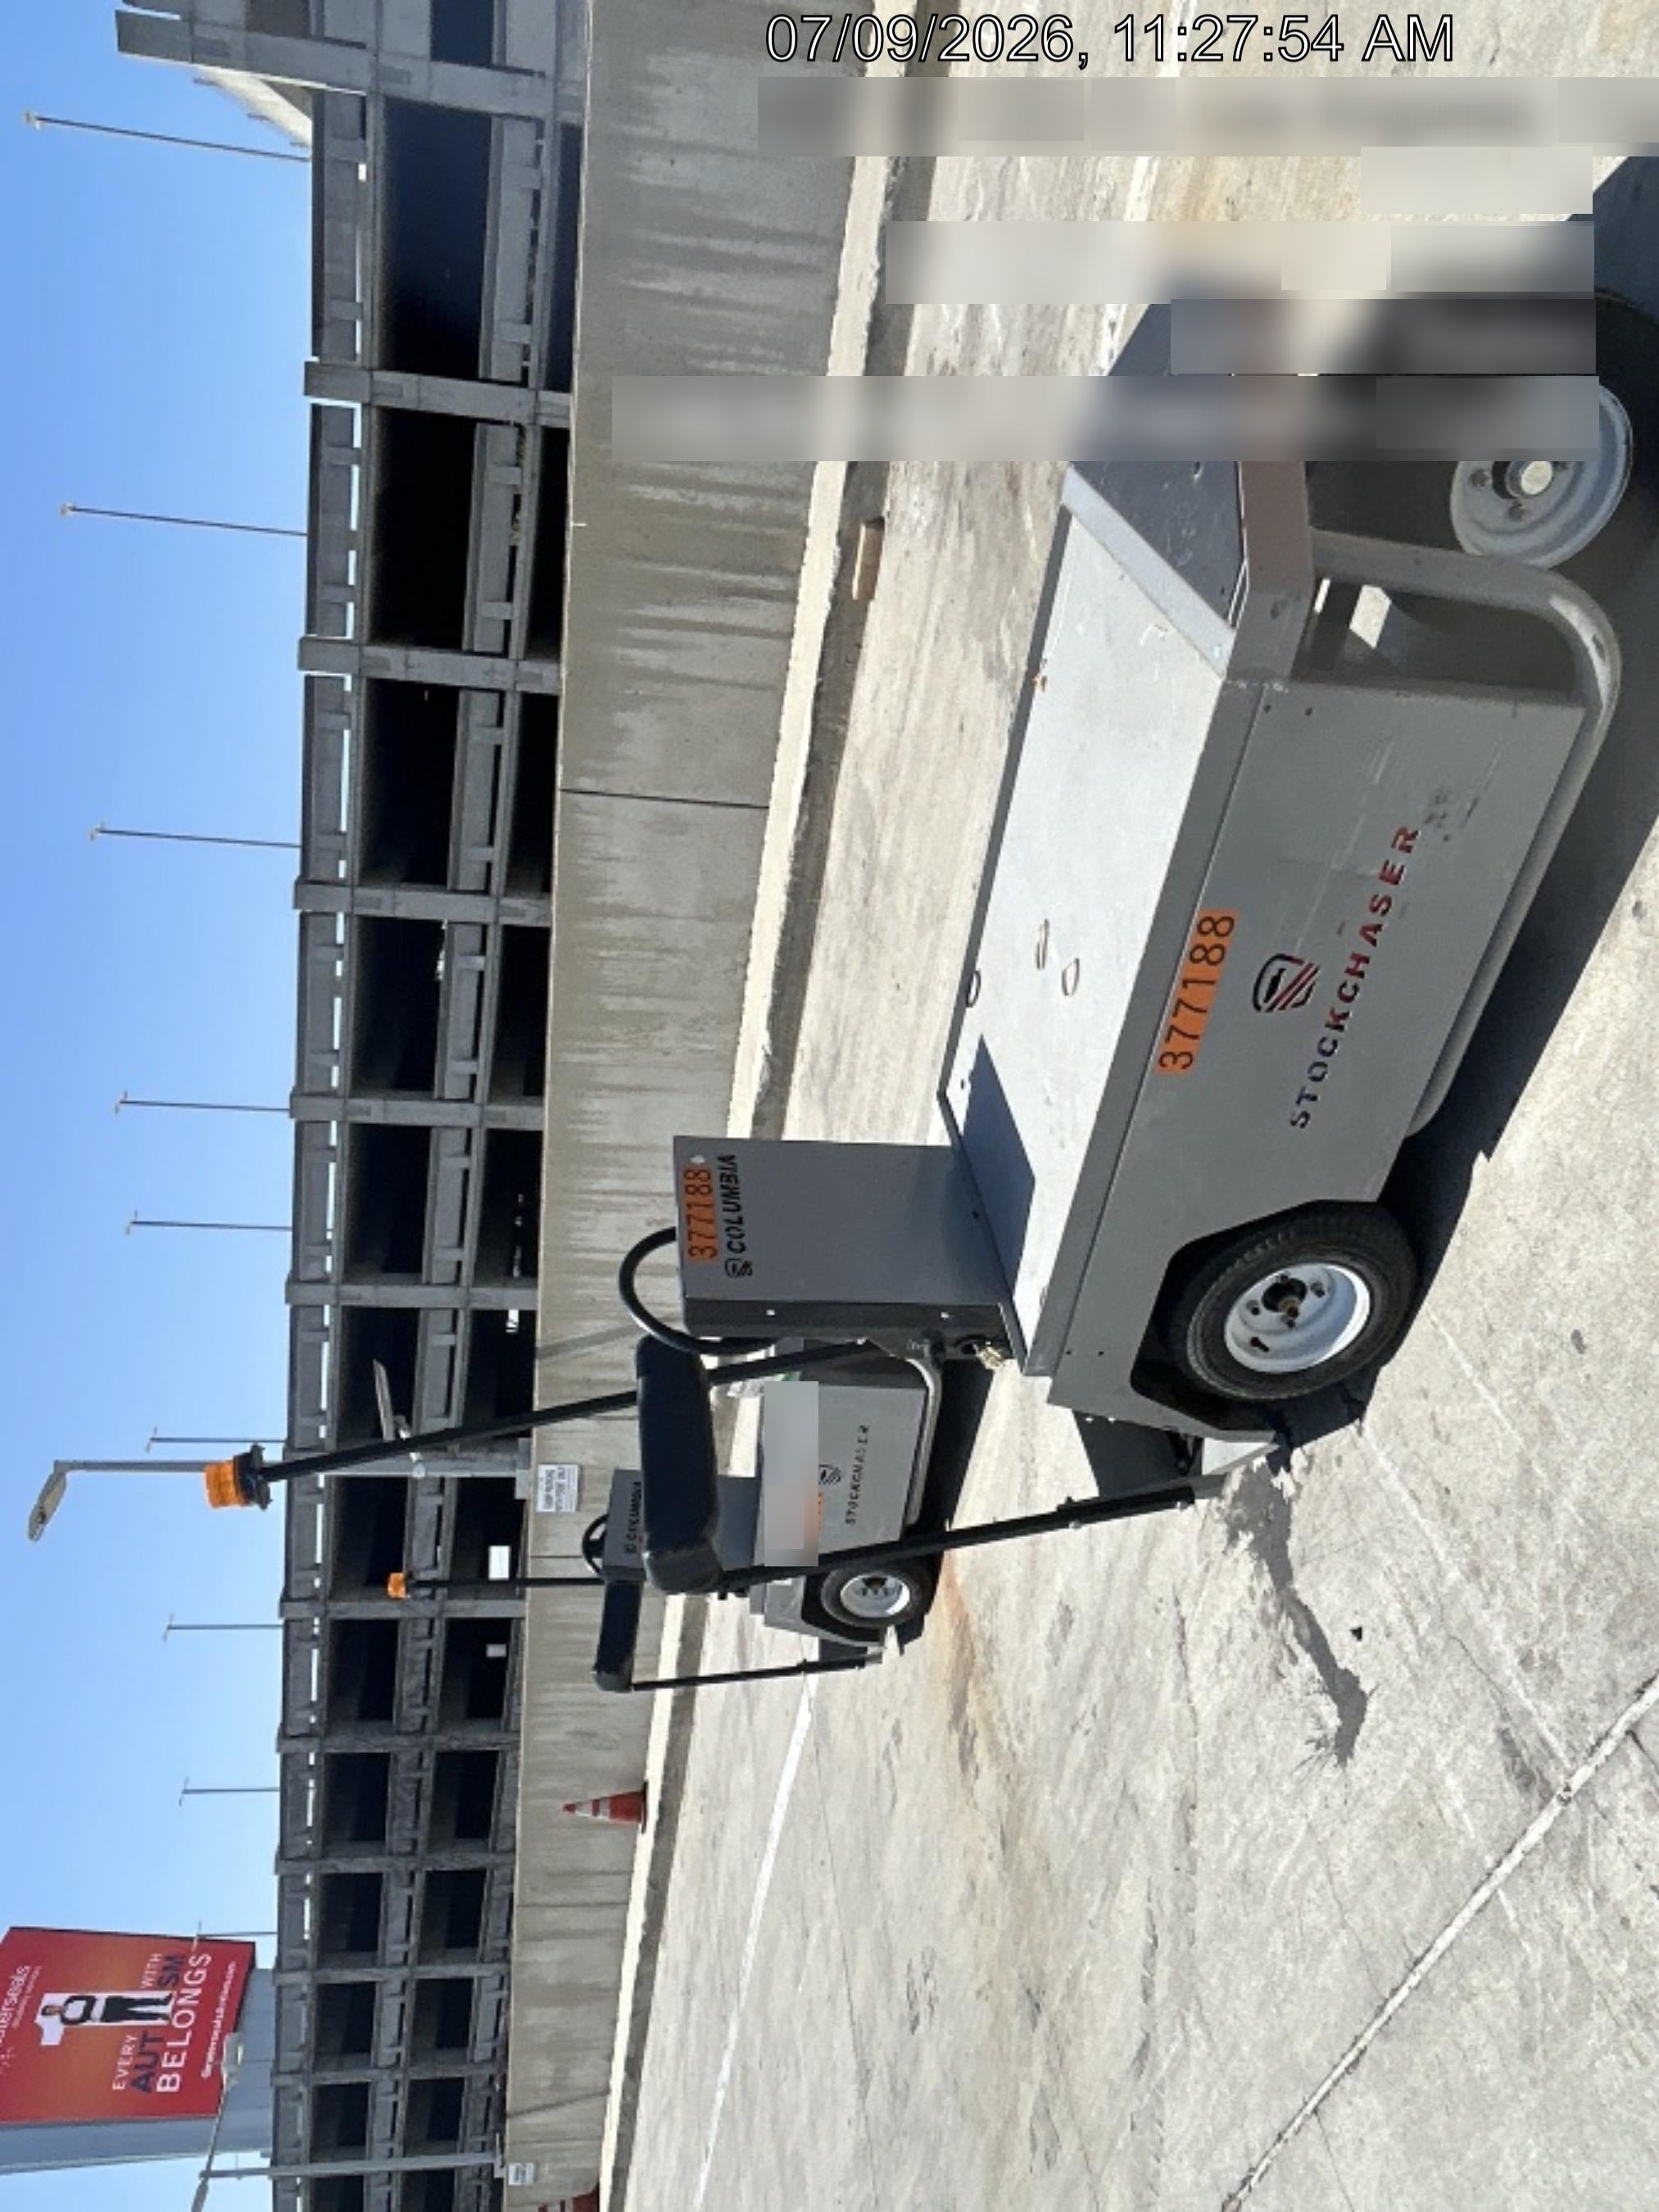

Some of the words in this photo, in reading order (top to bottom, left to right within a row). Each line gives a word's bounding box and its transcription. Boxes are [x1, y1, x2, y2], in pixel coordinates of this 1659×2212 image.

[1158, 915, 1235, 1070] 377188
[1290, 827, 1421, 1129] STOCKCHASER
[683, 1168, 718, 1260] 377188
[718, 1154, 747, 1254] COLUMBIA
[112, 2034, 138, 2091] EVERY
[140, 1953, 163, 1989] WITH
[156, 1953, 212, 2093] BELONGS
